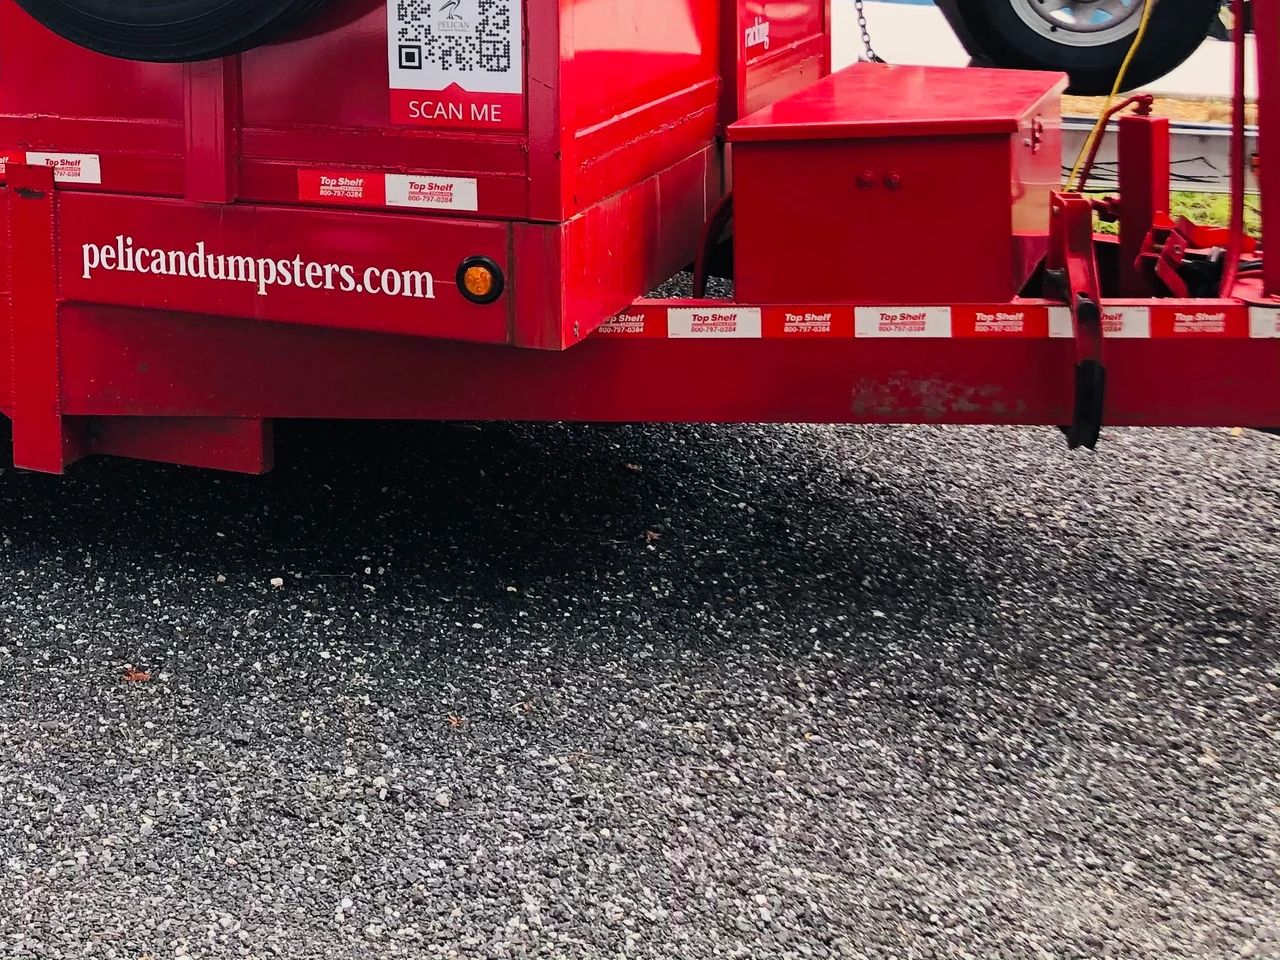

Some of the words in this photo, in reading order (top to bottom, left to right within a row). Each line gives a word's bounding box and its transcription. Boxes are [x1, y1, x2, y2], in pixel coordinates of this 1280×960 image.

[409, 100, 463, 120] SCAN
[471, 103, 502, 122] ME
[45, 158, 59, 167] Top
[320, 176, 337, 187] Top
[337, 178, 363, 186] Shelf
[409, 182, 426, 192] Top
[427, 183, 453, 191] Shelf
[82, 235, 435, 299] pelicandumpsters.com
[619, 314, 645, 322] Shelf
[692, 314, 709, 324] Top
[711, 313, 737, 321] Shelf
[785, 313, 803, 324] Top
[804, 313, 832, 321] Shelf
[879, 313, 897, 323] Top
[899, 313, 927, 321] Shelf
[976, 313, 994, 323] Top
[995, 313, 1024, 321] Shelf
[1174, 312, 1194, 323] Top
[1195, 312, 1226, 321] Shelf
